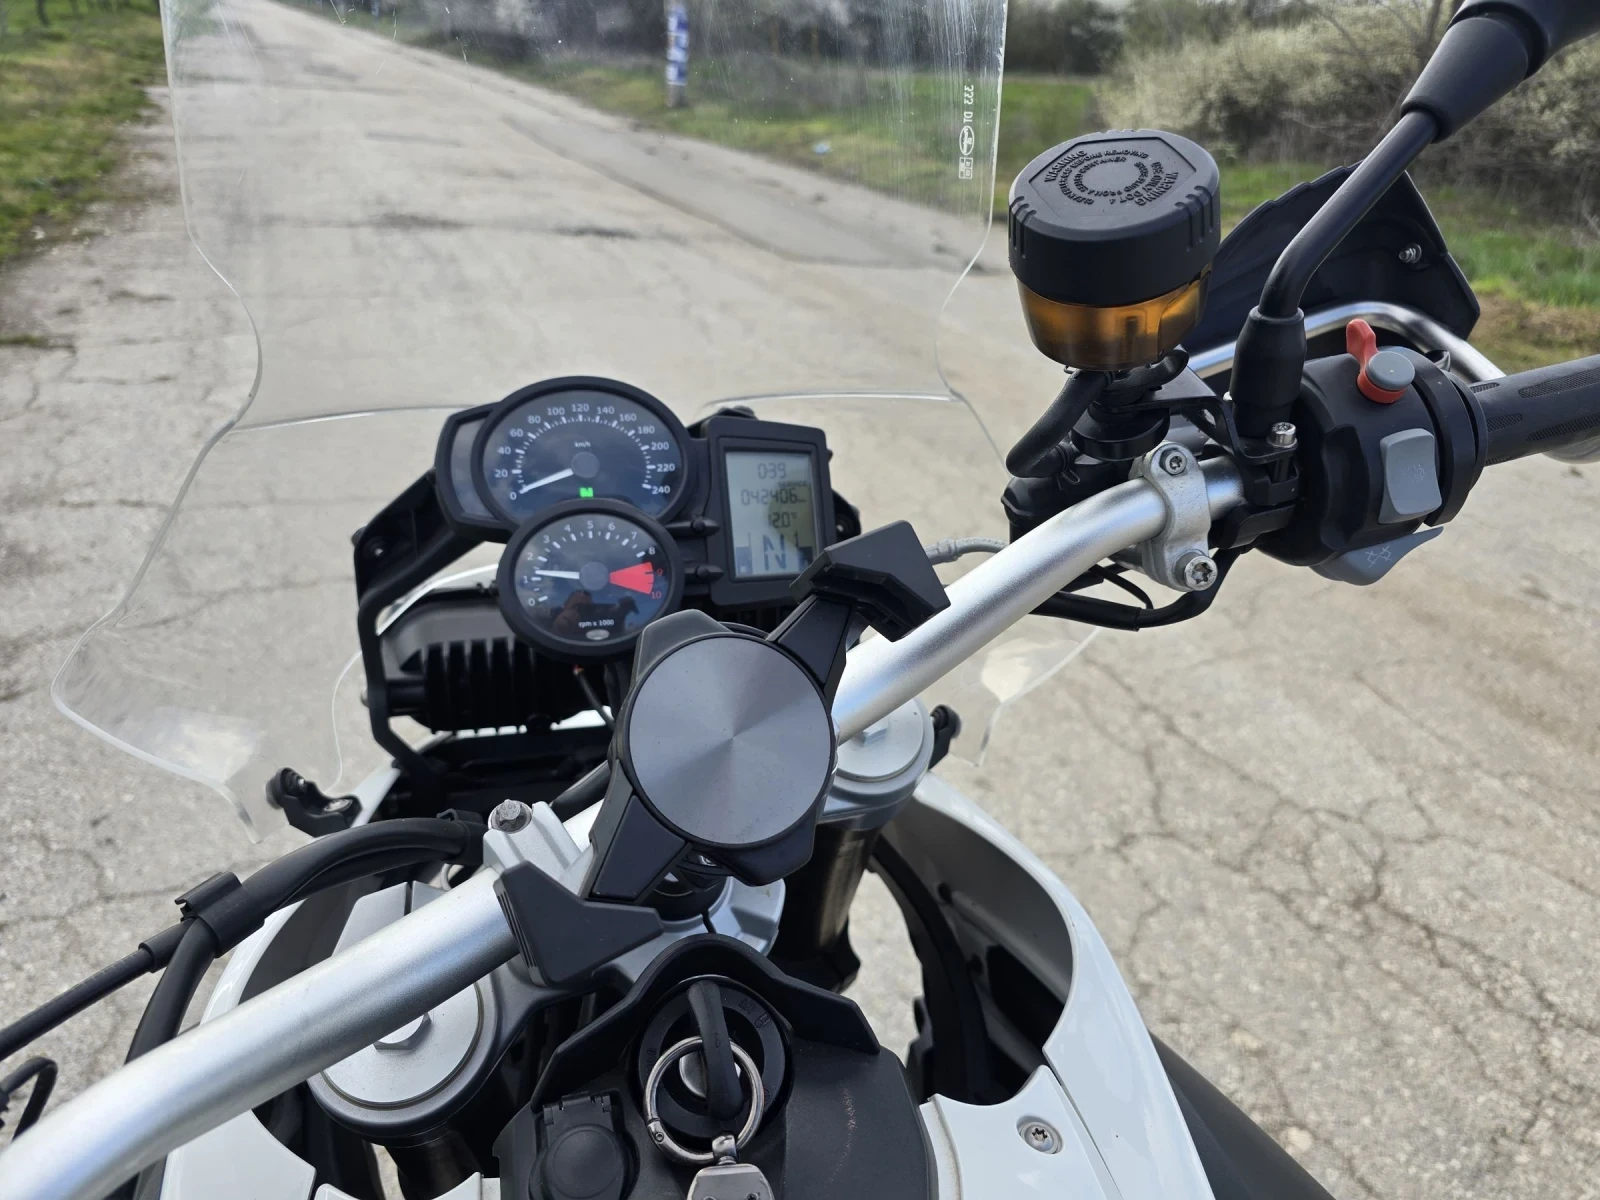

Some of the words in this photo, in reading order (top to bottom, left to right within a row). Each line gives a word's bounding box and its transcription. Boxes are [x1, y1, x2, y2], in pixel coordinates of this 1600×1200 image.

[1104, 149, 1149, 159] REMOVING
[1044, 150, 1087, 182] WARNING
[1134, 172, 1179, 206] WARNING
[1120, 190, 1144, 204] DOT
[547, 407, 565, 416] 100
[571, 403, 589, 413] 120
[597, 406, 615, 415] 140
[528, 415, 541, 424] 80
[620, 413, 637, 422] 160
[510, 428, 523, 437] 60
[637, 425, 655, 434] 180
[651, 441, 669, 450] 200
[498, 446, 511, 455] 40
[657, 463, 675, 473] 220
[494, 469, 508, 478] 20
[652, 485, 670, 495] 240
[510, 491, 517, 501] 0
[564, 524, 571, 532] 4
[587, 520, 594, 530] 5
[608, 522, 615, 531] 6
[543, 534, 550, 544] 3
[632, 531, 638, 540] 7
[648, 546, 656, 555] 8
[762, 532, 787, 571] N
[527, 552, 533, 561] 2
[656, 568, 663, 577] 9
[523, 575, 529, 584] 1
[652, 591, 662, 599] 10
[528, 597, 535, 607] 0
[578, 621, 592, 629] rpm
[599, 619, 615, 627] 1000
